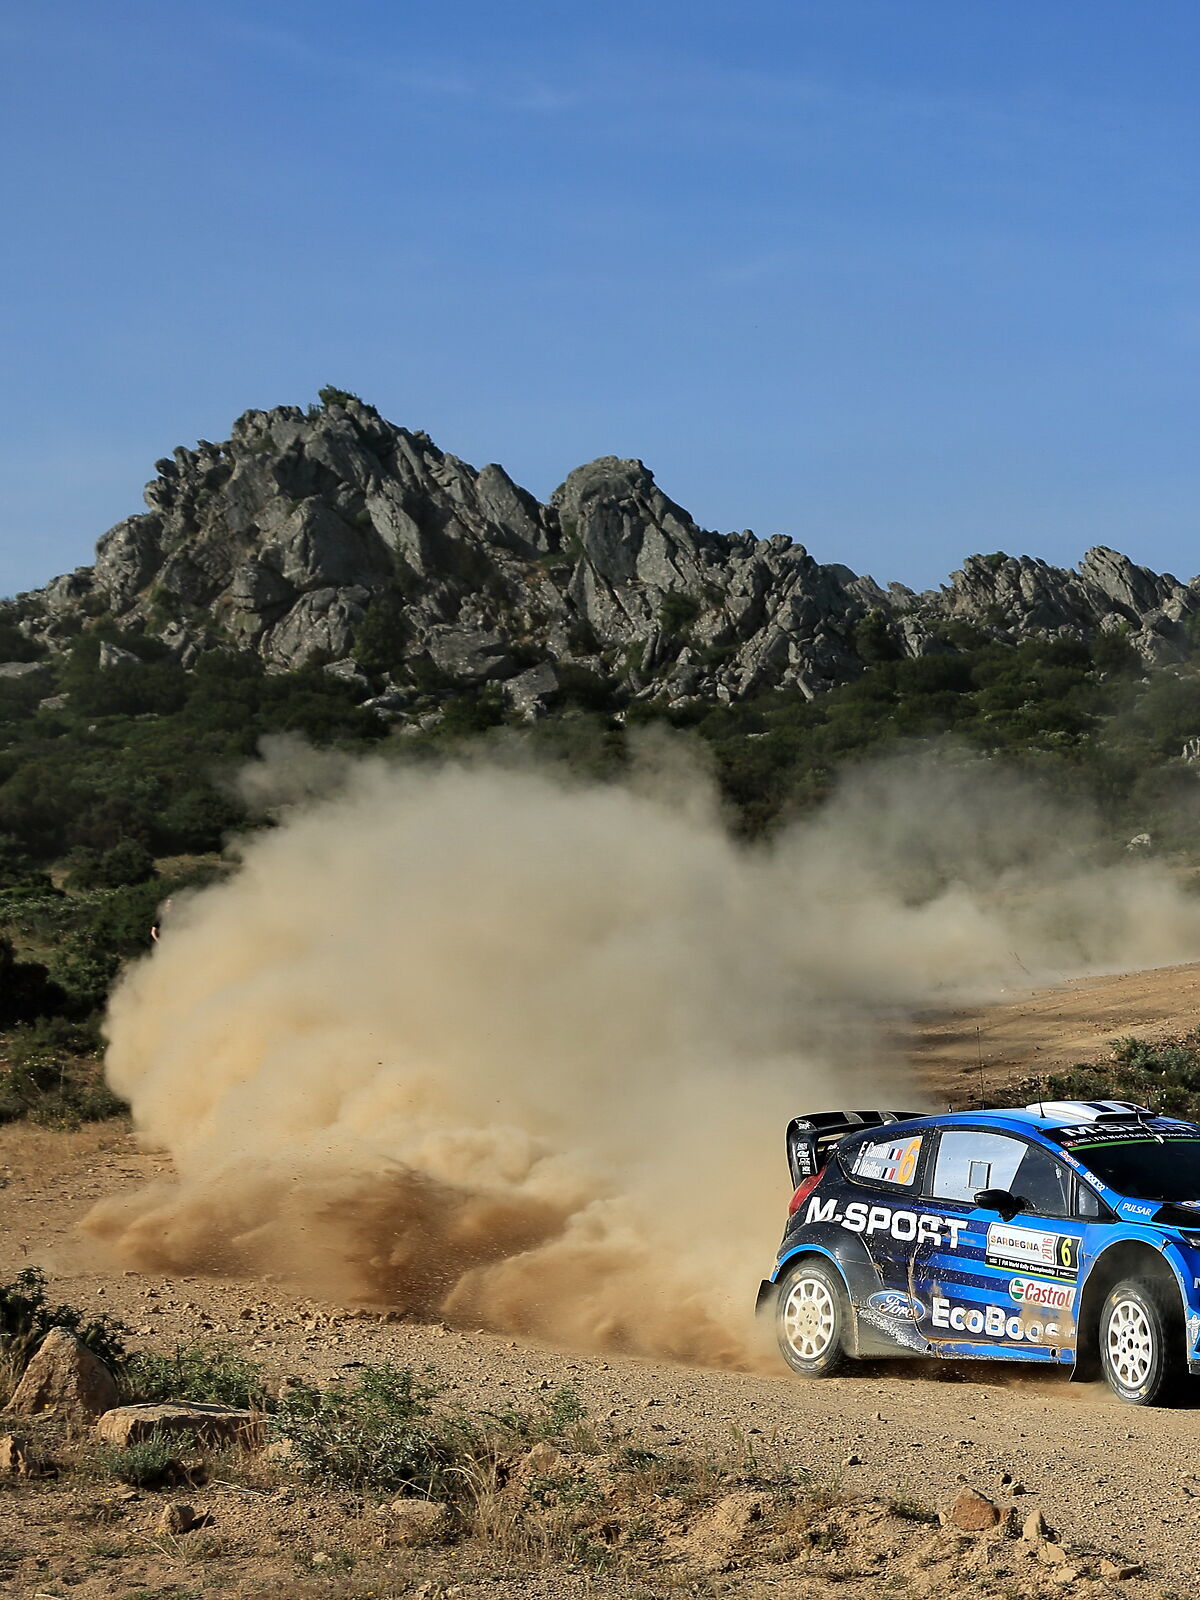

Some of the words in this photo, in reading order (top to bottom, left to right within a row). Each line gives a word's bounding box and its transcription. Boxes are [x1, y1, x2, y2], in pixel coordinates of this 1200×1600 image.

[897, 1139, 921, 1184] 6
[1122, 1203, 1152, 1217] PULSAR
[990, 1235, 1040, 1252] SARDEGNA
[1041, 1238, 1054, 1260] 2016
[1060, 1238, 1073, 1267] 6
[878, 1293, 918, 1320] Ford
[1024, 1283, 1072, 1308] Castrol
